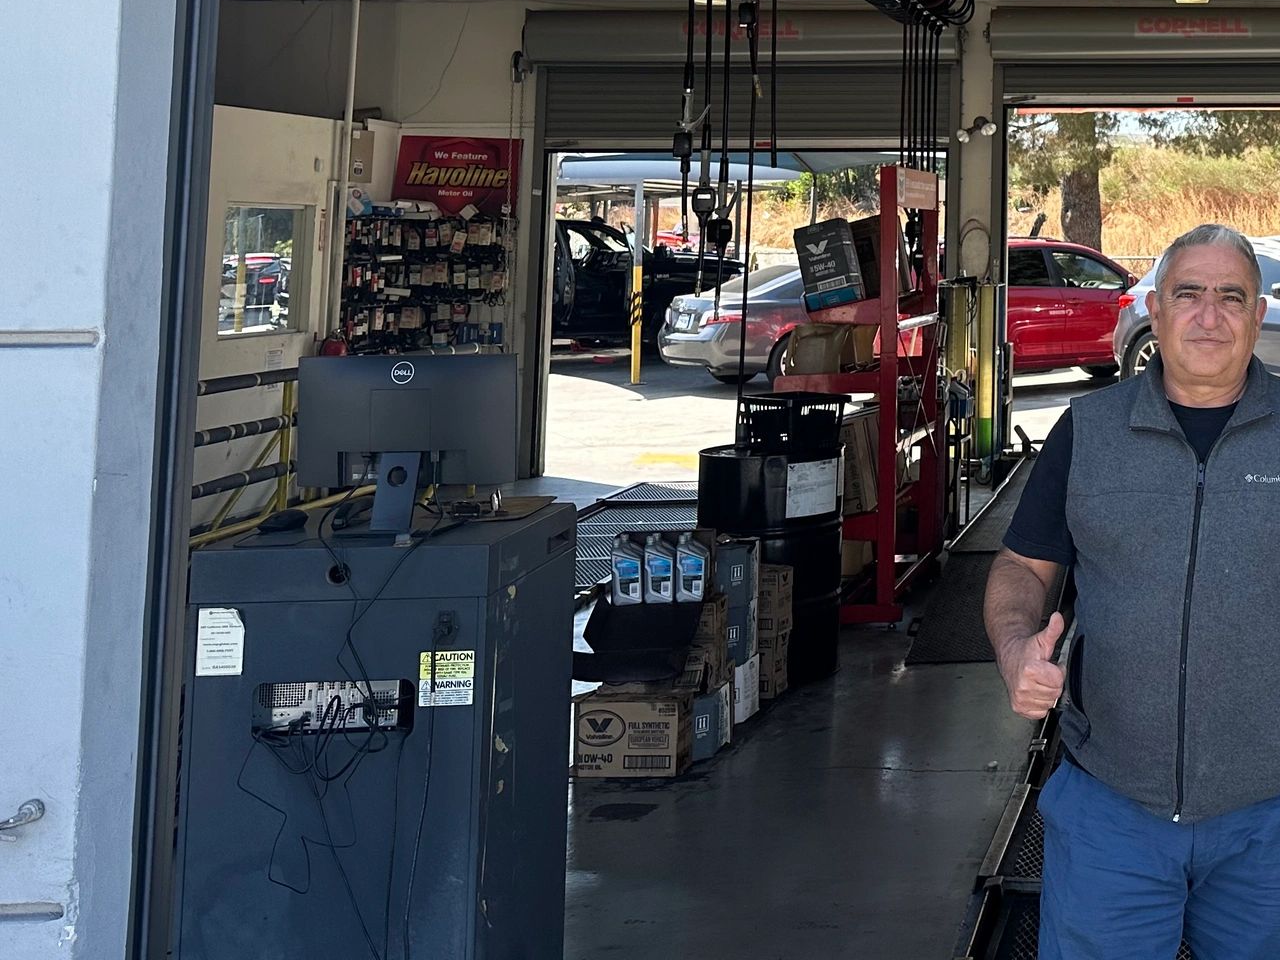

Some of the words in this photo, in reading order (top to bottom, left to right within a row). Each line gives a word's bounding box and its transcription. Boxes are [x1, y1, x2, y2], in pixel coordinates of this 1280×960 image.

[1136, 16, 1250, 35] CORNELL
[434, 151, 449, 160] We
[451, 151, 488, 161] Feature
[406, 161, 509, 188] Havoline
[814, 260, 836, 272] 5W-40
[434, 652, 473, 661] CAUTION
[641, 721, 670, 730] SYNTHETIC
[584, 753, 613, 764] 0W-40
